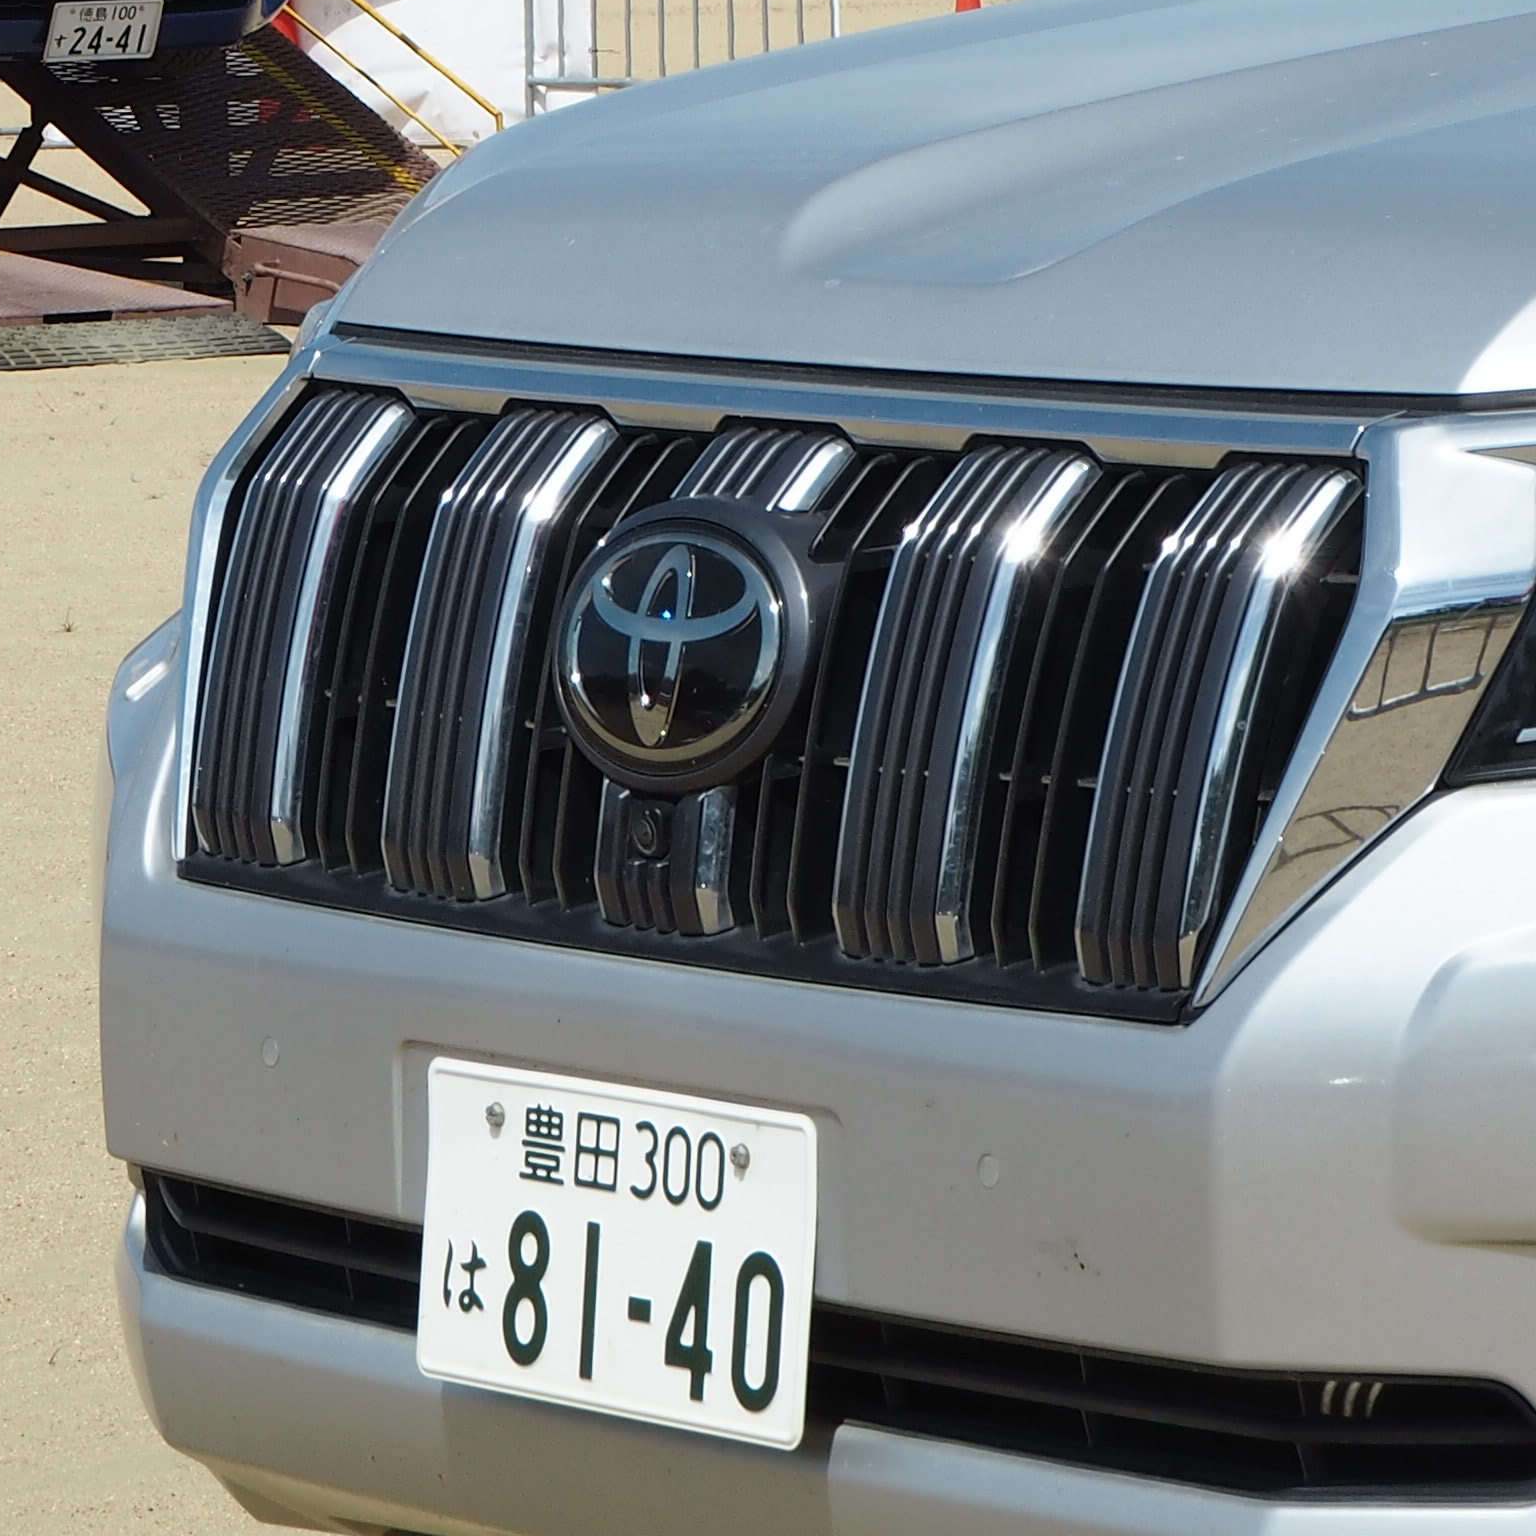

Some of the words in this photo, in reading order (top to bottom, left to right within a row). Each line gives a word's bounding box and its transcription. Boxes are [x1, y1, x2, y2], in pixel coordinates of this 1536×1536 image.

[68, 24, 147, 55] 24-41
[442, 1237, 487, 1314] は
[501, 1208, 785, 1413] 81-40
